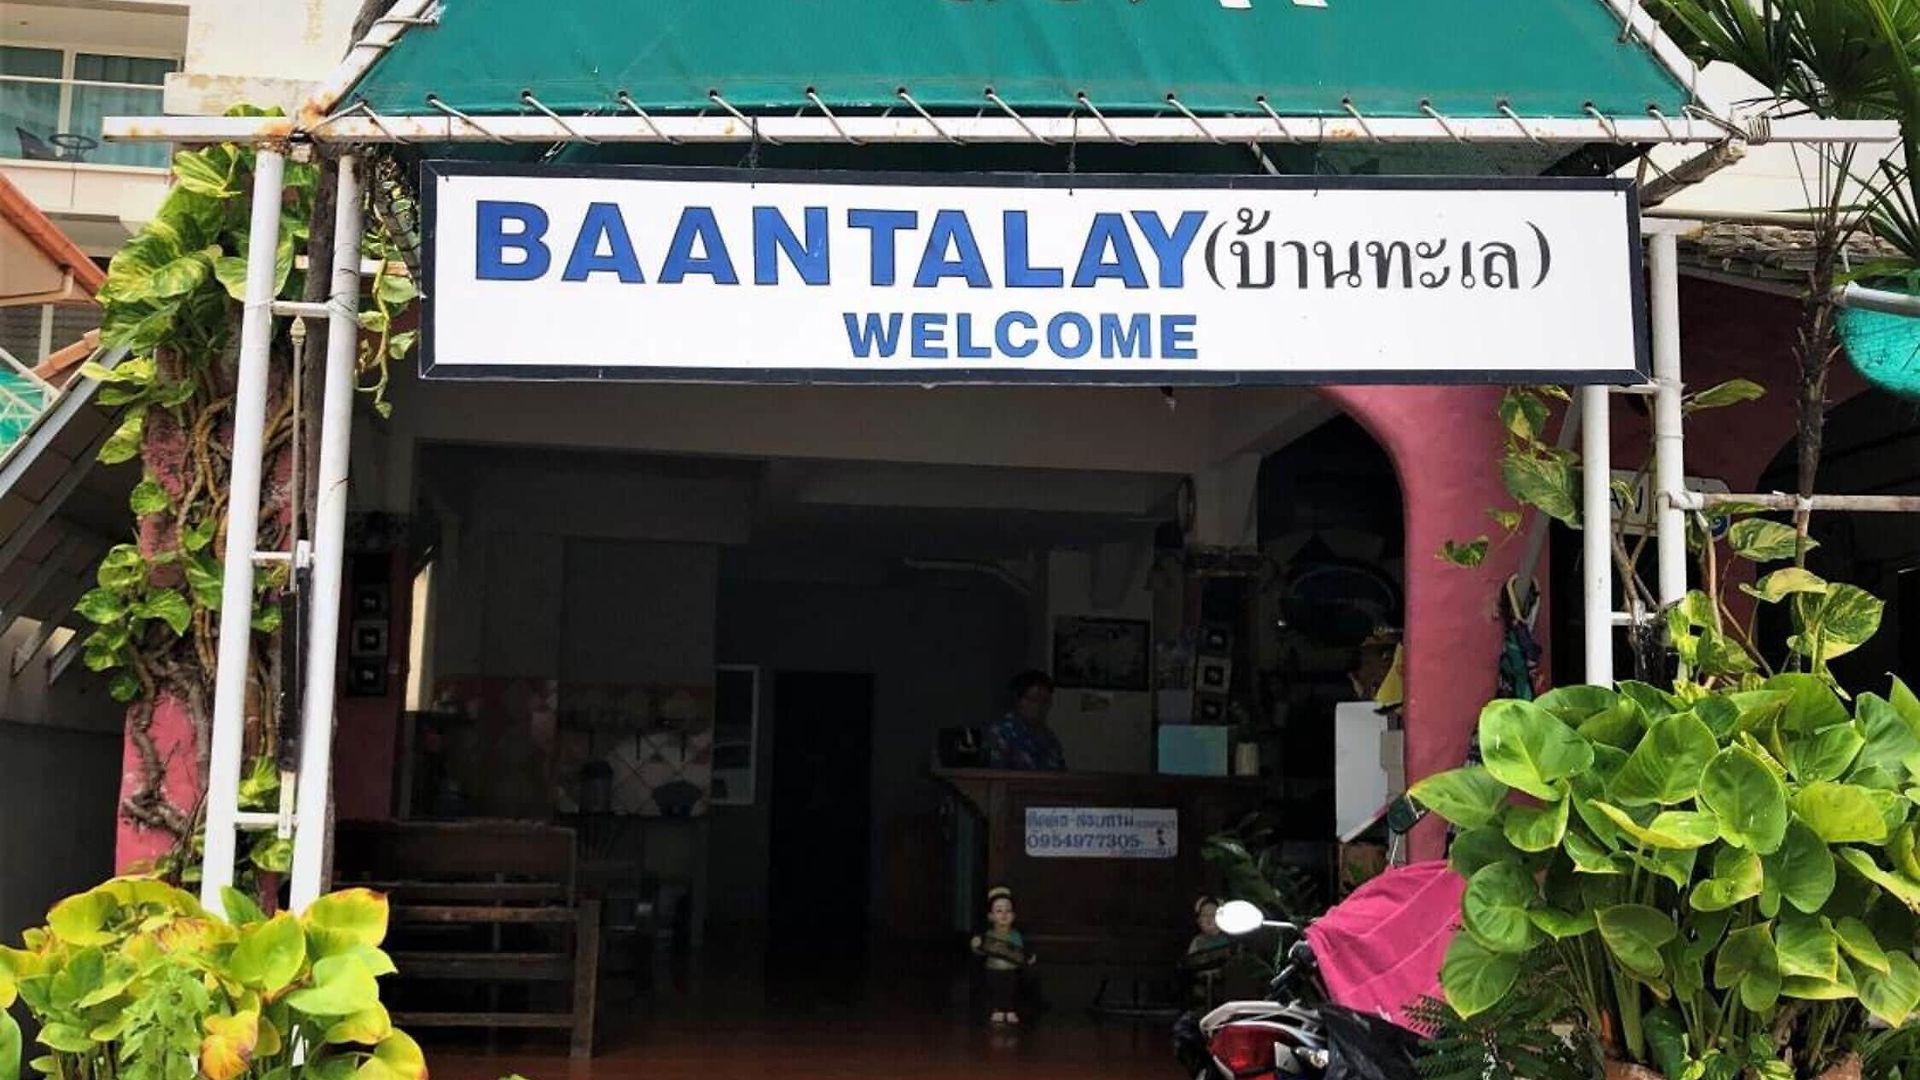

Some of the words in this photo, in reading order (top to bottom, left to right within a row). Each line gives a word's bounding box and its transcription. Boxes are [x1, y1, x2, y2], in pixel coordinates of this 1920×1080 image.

[475, 200, 1206, 289] BAANTALAY
[845, 311, 1197, 360] WELCOME
[1027, 834, 1140, 848] 0954977305
